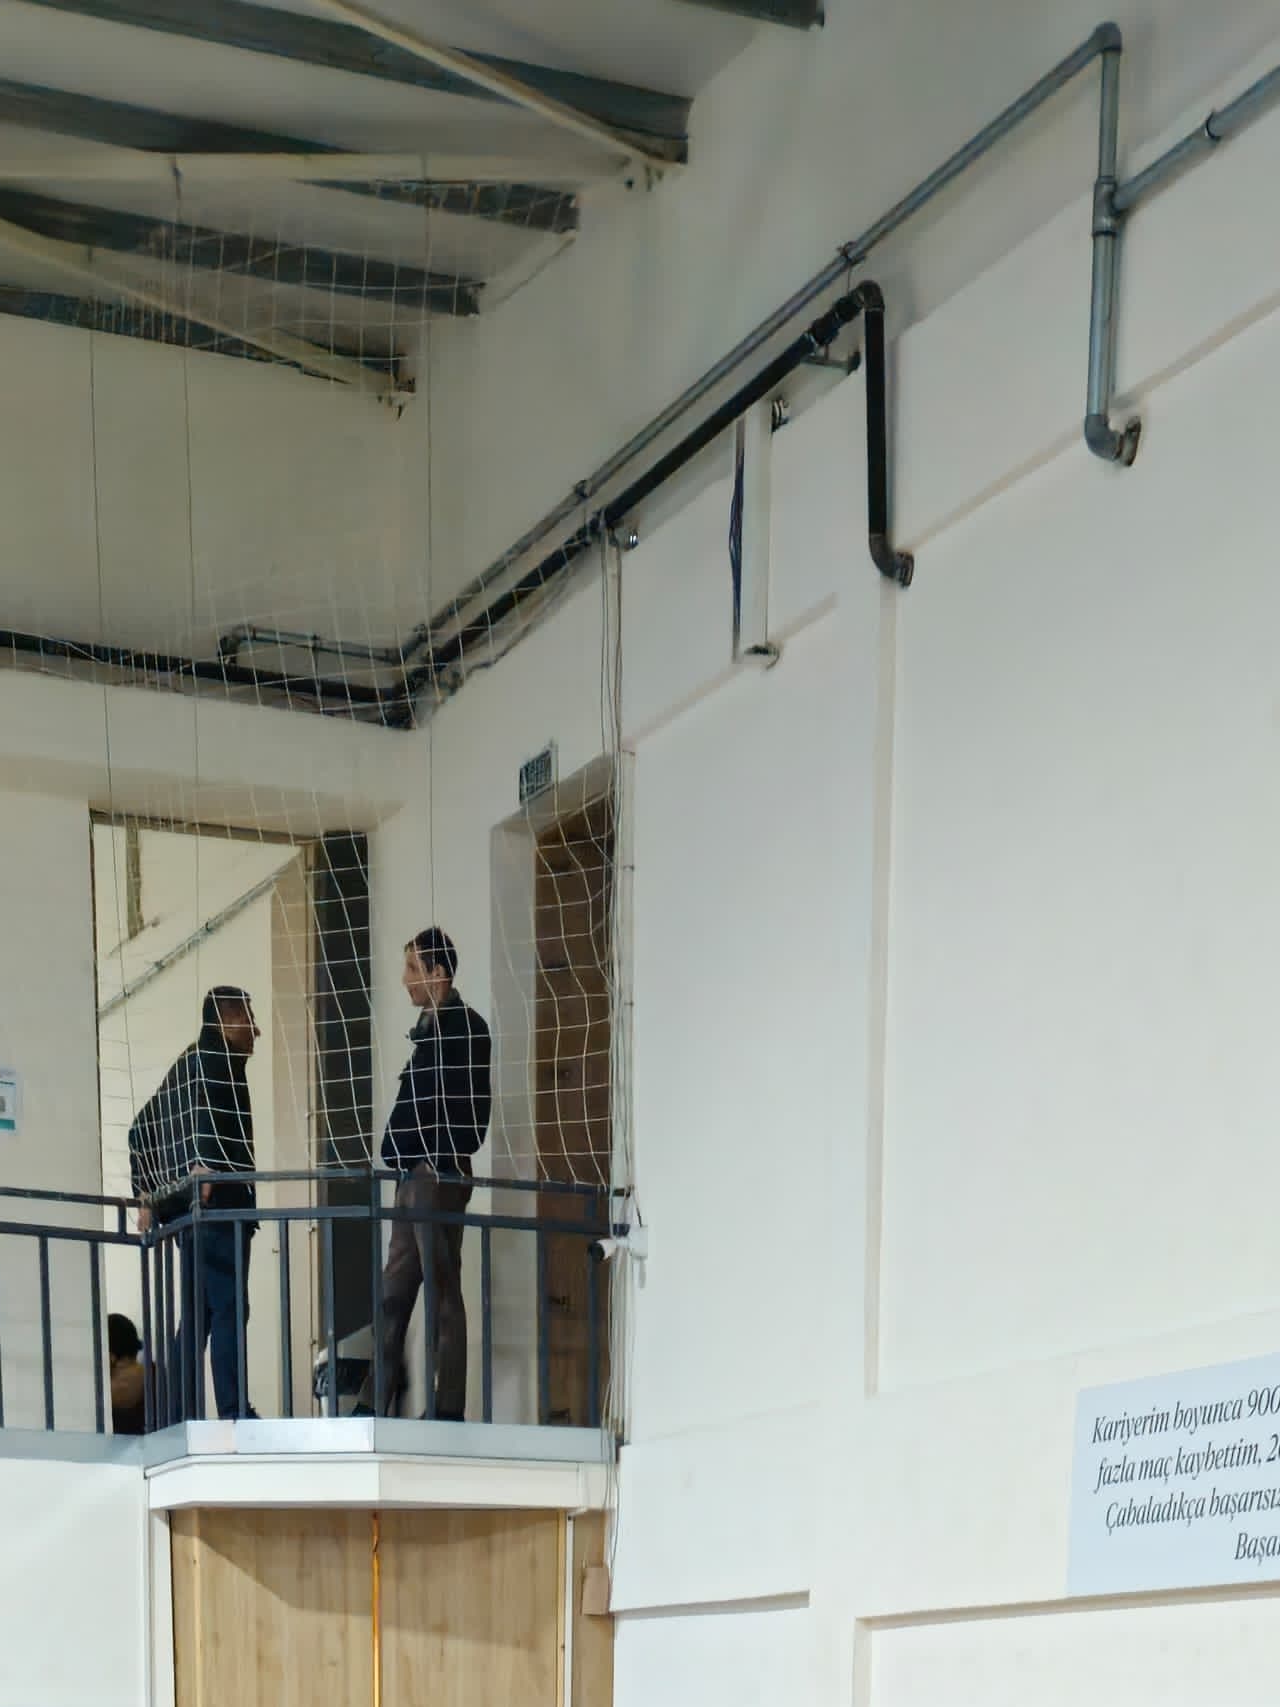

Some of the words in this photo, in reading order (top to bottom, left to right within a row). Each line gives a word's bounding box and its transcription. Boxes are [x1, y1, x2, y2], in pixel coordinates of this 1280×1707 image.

[1092, 1406, 1170, 1446] Kariyerim
[1173, 1400, 1244, 1436] boyunca
[1093, 1455, 1135, 1494] fazla
[1138, 1457, 1171, 1486] maç
[1174, 1438, 1262, 1481] kaybettim,
[1105, 1491, 1205, 1535] Çabaladıkça
